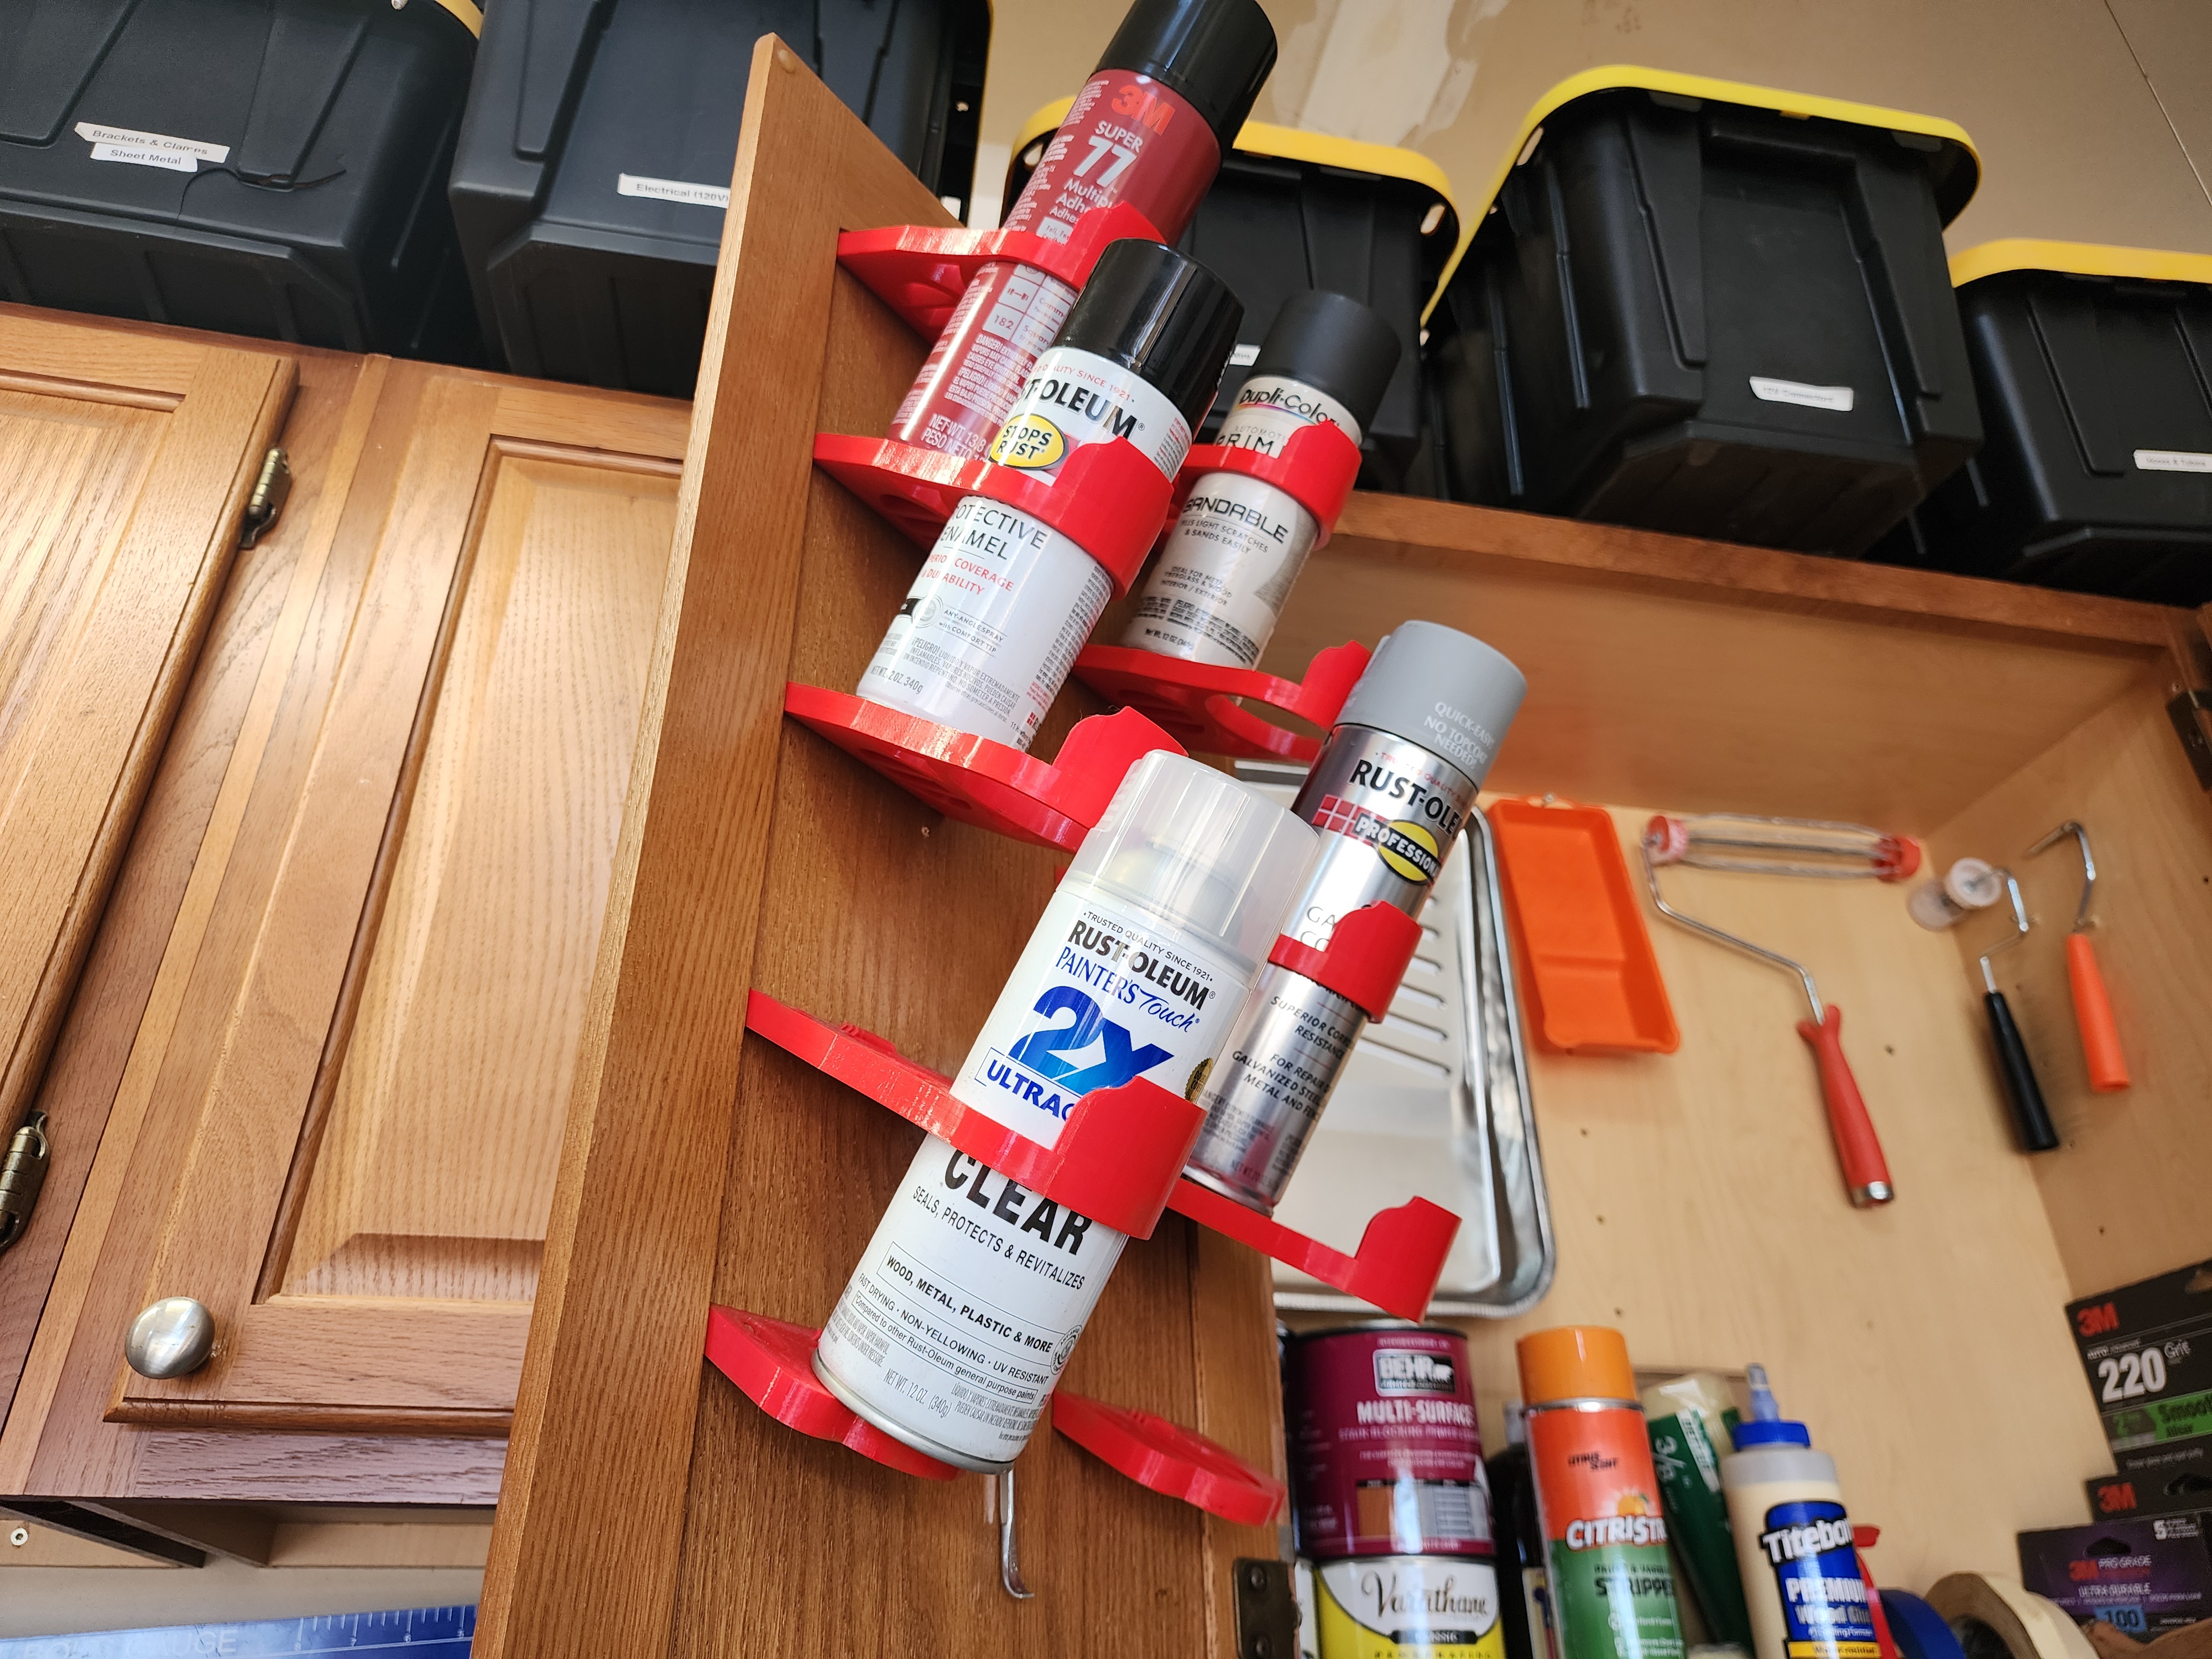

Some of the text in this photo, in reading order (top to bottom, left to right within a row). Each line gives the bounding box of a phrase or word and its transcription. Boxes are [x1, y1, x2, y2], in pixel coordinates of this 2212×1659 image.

[1112, 85, 1176, 136] 3M
[93, 130, 145, 144] Brackets
[1095, 120, 1144, 153] SUPER
[111, 149, 181, 164] Sheet Metal
[1073, 135, 1138, 188] 77
[637, 184, 728, 202] Electrical (120V)
[995, 314, 1014, 330] 182
[968, 353, 984, 365] CAUSES
[972, 343, 990, 356] VAPORS
[989, 351, 1001, 362] MAY
[976, 334, 1003, 352] DANGER!
[957, 367, 985, 385] ¡PELIGRO!
[1076, 370, 1130, 402] SINCE 1921
[1023, 377, 1138, 439] T-OLEUM
[921, 427, 947, 449] PESO
[928, 414, 950, 432] NET
[948, 421, 965, 439] WT.
[1004, 425, 1053, 447] STOPS
[996, 441, 1040, 460] RUST
[1215, 434, 1286, 460] PRIM
[1183, 497, 1288, 544] SANDABLE
[1196, 519, 1268, 553] LIGHT SCRATCHES
[1191, 529, 1251, 554] SANDS EASILY
[926, 568, 986, 596] DUABILITY
[954, 557, 1015, 592] COVERAGE
[1172, 566, 1203, 578] IDEAL FOR
[1194, 588, 1228, 607] EXTERIOR
[1209, 582, 1232, 598] WOOD
[939, 622, 997, 653] with COMFORT TIP
[943, 609, 1004, 643] ANY-ANGLE SPRAY
[904, 676, 924, 695] 340g
[909, 654, 930, 670] INCENDIO
[958, 679, 967, 688] NO
[966, 683, 989, 702] SOMETER
[911, 637, 940, 655] ¡PELIGRO!
[959, 660, 965, 668] Y
[964, 663, 980, 677] VAPOR
[979, 672, 1020, 703] EXTREMADAMENTE
[942, 660, 963, 677] VAPORES
[984, 685, 1002, 700] PUEDEN
[1424, 716, 1446, 734] NO
[1348, 759, 1461, 837] RUST-OLE
[1355, 815, 1439, 877] PROFESSION
[1087, 911, 1211, 981] TRUSTED QUALITY SINCE 1921
[1068, 920, 1210, 1011] RUST-OLEUM
[1055, 946, 1196, 1034] PAINTER'S Touch
[1271, 996, 1327, 1032] SUPERIOR
[1008, 985, 1175, 1096] 2X
[1232, 1050, 1298, 1092] GALVANIZED
[1270, 1053, 1295, 1072] FOR
[1243, 1073, 1303, 1113] METAL AND
[944, 1150, 1093, 1255] CLEAR
[914, 1186, 1085, 1290] SEALS, PROTECTS & REVITALIZES
[886, 1255, 915, 1287] WOOD,
[916, 1278, 957, 1313] METAL,
[959, 1305, 1013, 1339] PLASTIC
[1013, 1331, 1022, 1343] &
[1024, 1336, 1053, 1353] MORE
[2077, 1302, 2120, 1337] 3M
[858, 1272, 1049, 1385] FAST DRYING NON-YELLOWING UV RESISTANT
[880, 1318, 886, 1328] to
[888, 1323, 907, 1342] other
[908, 1337, 954, 1371] Rust-Oleum
[954, 1366, 987, 1385] general
[986, 1380, 1016, 1397] purpose
[1016, 1390, 1035, 1401] paints
[1380, 1356, 1434, 1381] BEHR
[2098, 1348, 2167, 1403] 220
[2164, 1339, 2190, 1359] Grit
[884, 1368, 952, 1418] NET WT. 12 OZ. (340g)
[2098, 1482, 2137, 1512] 3M
[2153, 1520, 2166, 1540] 5
[2099, 1557, 2117, 1569] PRO
[2118, 1555, 2151, 1567] GRADE
[2078, 1582, 2151, 1597] ULTRA DURABLE
[2105, 1610, 2139, 1627] 100
